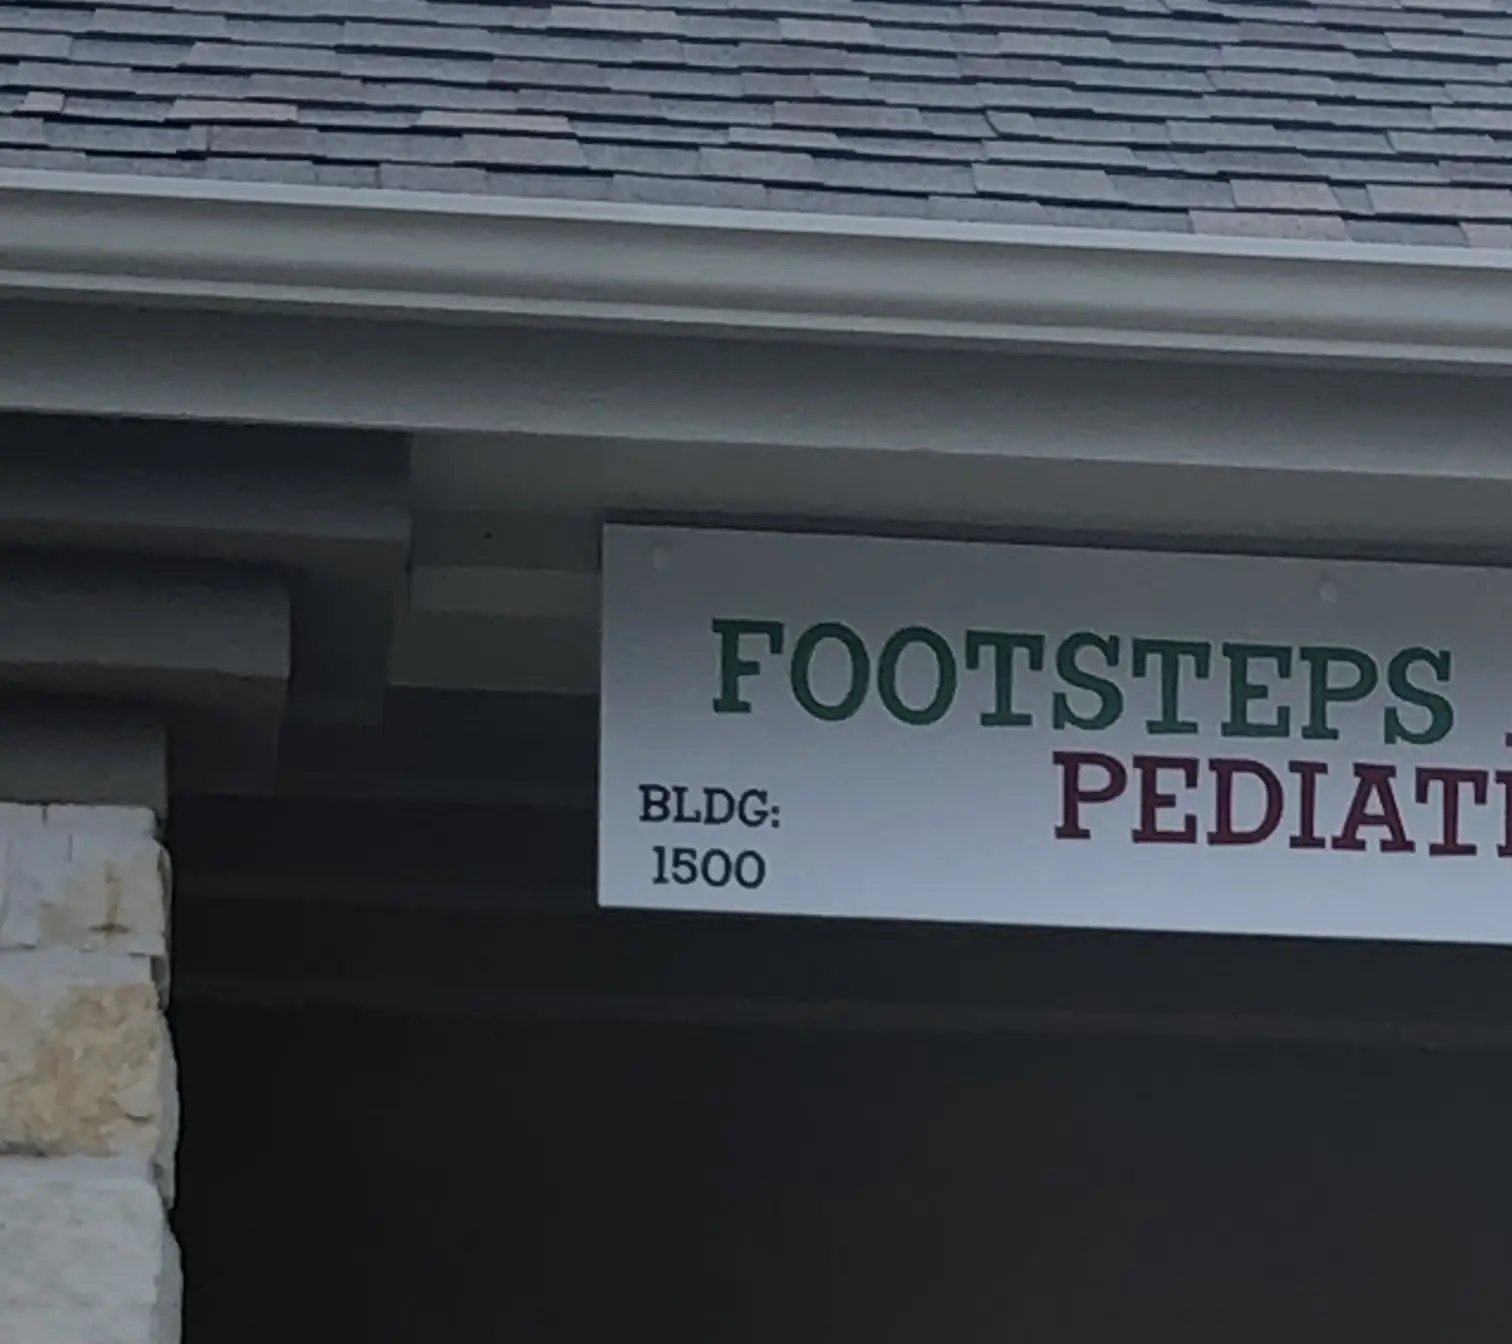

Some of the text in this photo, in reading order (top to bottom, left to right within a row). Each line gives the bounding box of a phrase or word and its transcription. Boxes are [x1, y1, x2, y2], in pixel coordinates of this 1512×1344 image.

[710, 616, 1455, 746] FOOTSTEPS
[636, 782, 781, 830] BLDG:
[651, 844, 767, 890] 1500
